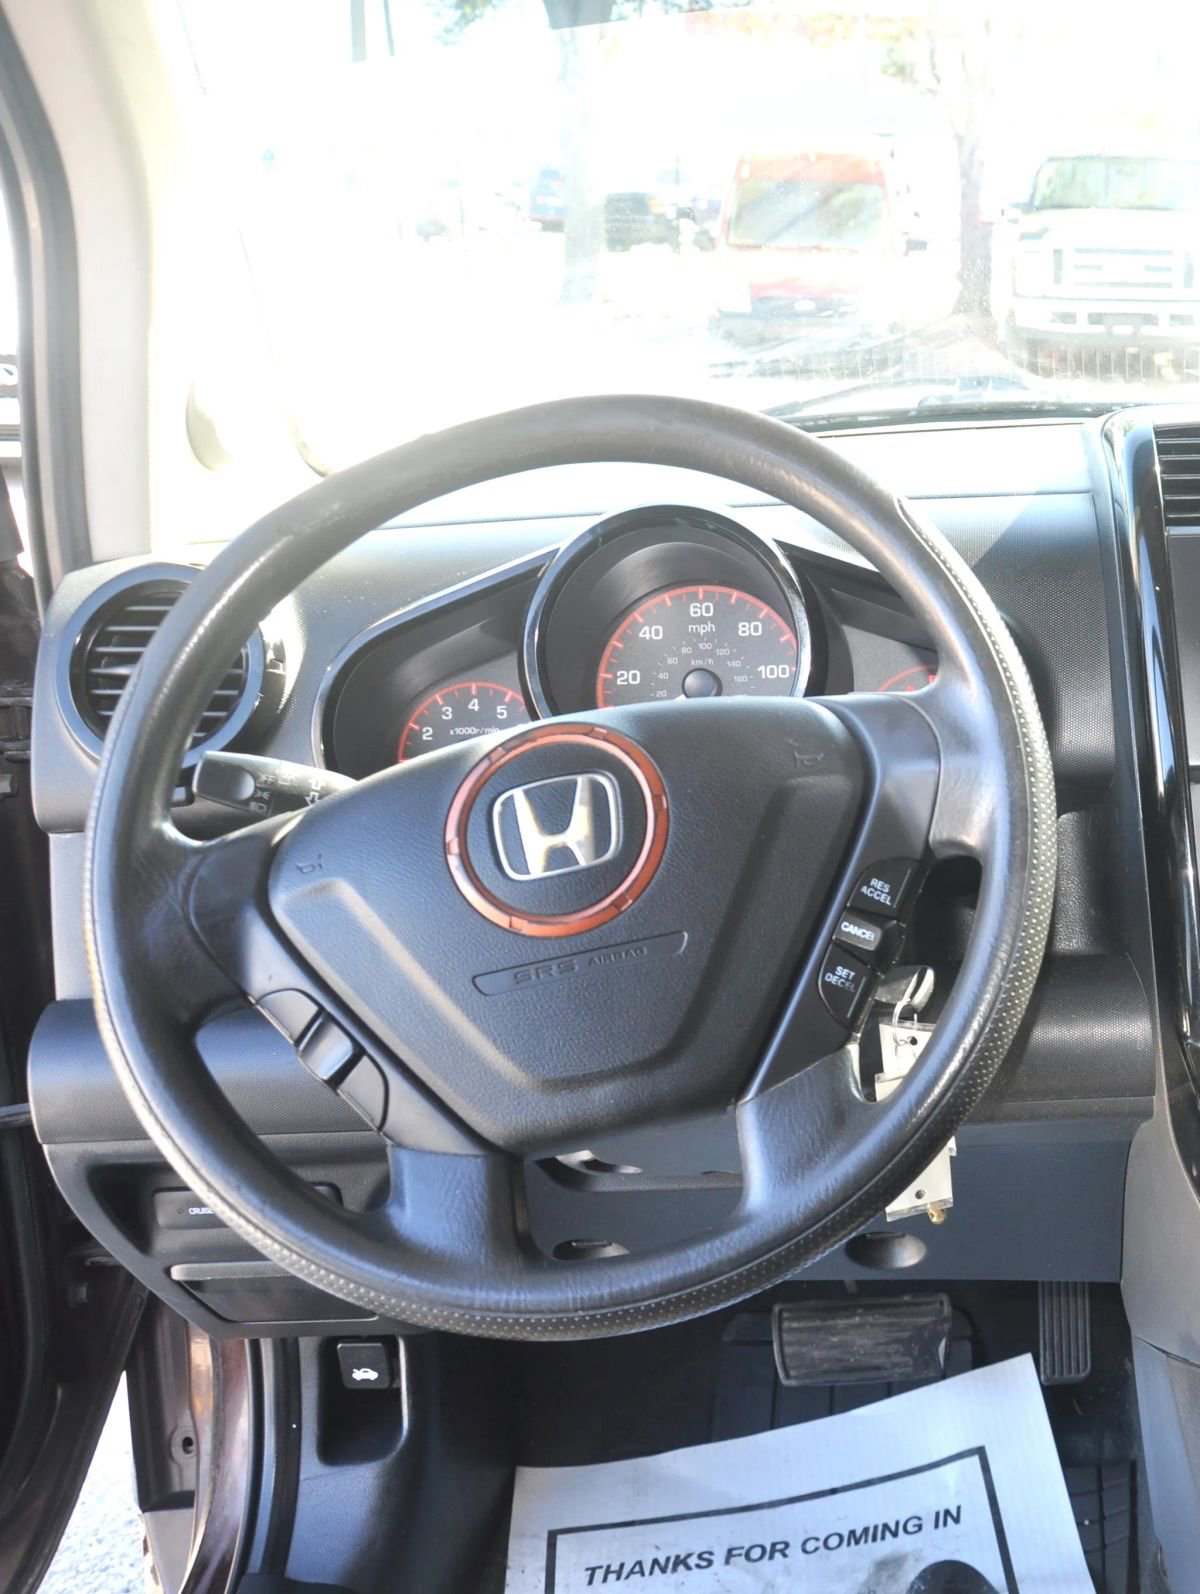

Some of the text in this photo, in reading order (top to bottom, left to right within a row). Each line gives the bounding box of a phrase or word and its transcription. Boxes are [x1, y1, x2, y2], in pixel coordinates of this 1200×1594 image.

[690, 603, 714, 617] 60
[638, 625, 663, 640] 40
[688, 621, 715, 636] mph
[738, 621, 762, 636] 80
[681, 646, 692, 654] 80
[698, 642, 712, 650] 100
[667, 657, 678, 665] 60
[727, 660, 741, 668] 140
[616, 670, 641, 685] 20
[757, 665, 790, 679] 100
[468, 698, 479, 711] 4
[441, 706, 453, 720] 3
[496, 706, 507, 719] 5
[422, 727, 433, 740] 2
[870, 878, 891, 893] RES
[860, 885, 892, 906] ACCEL
[840, 922, 876, 941] CANCEL
[513, 959, 578, 985] SRS
[835, 966, 855, 980] SET
[824, 972, 856, 993] DECEL
[584, 1505, 961, 1586] THANKS FOR COMING IN
